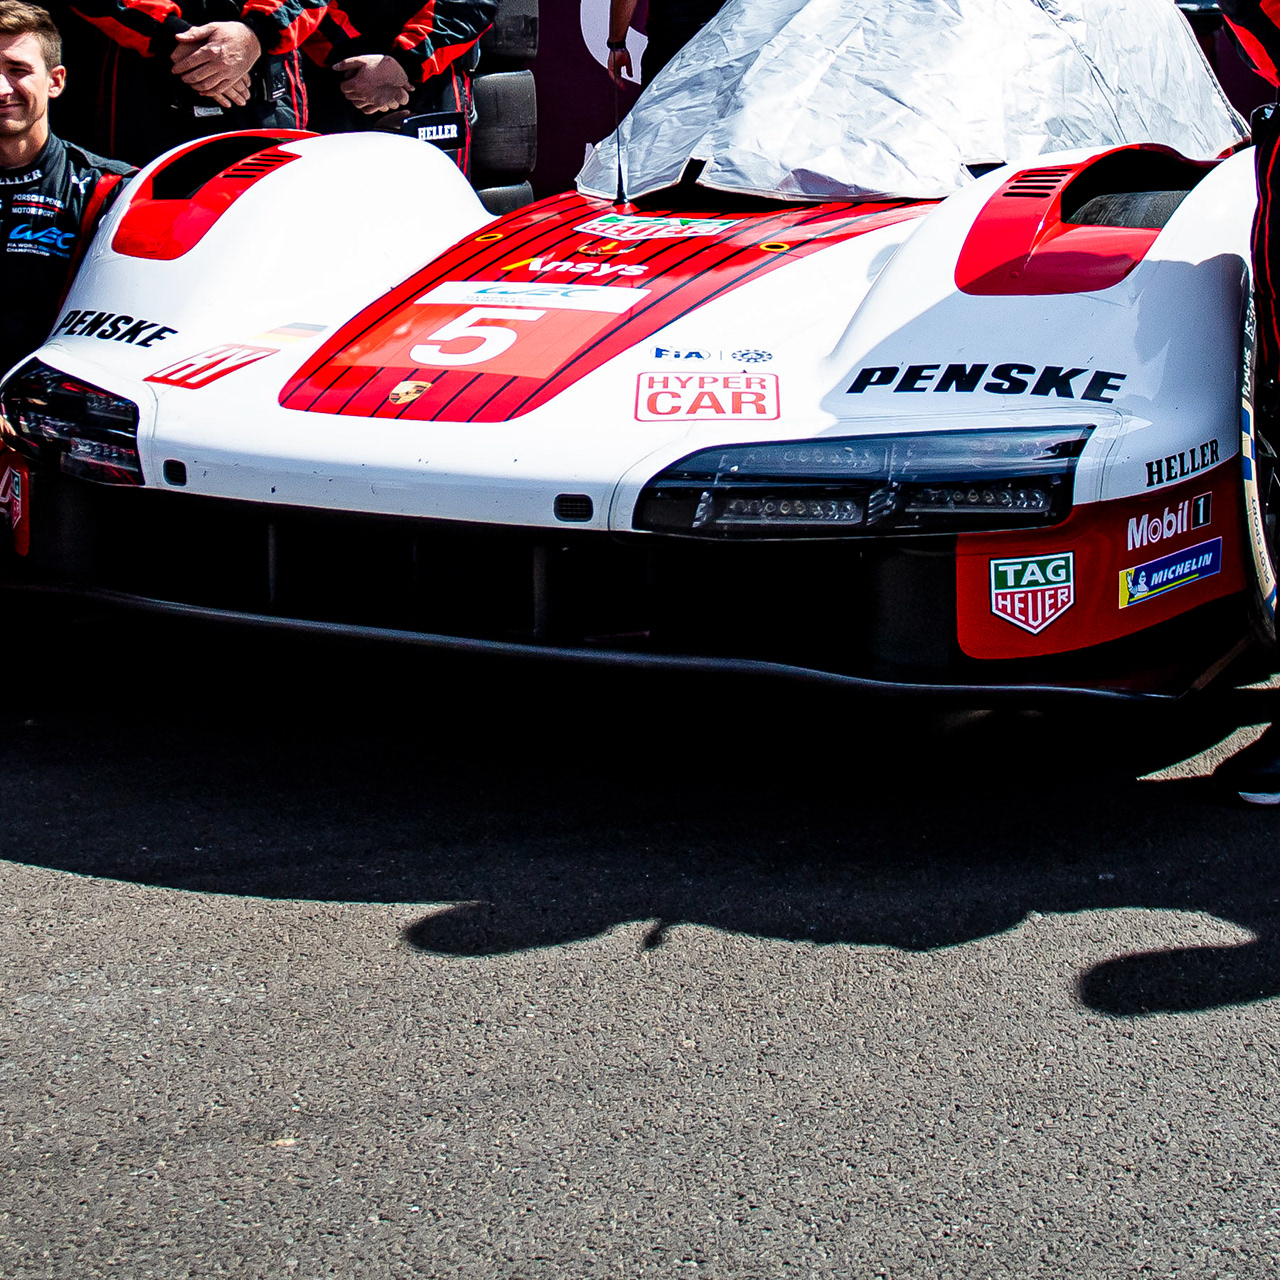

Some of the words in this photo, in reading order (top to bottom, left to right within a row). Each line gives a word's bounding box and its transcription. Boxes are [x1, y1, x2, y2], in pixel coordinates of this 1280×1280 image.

[418, 123, 459, 141] HELLER
[501, 258, 650, 278] Ansys
[53, 309, 180, 349] PENSKE
[409, 306, 548, 367] 5
[647, 375, 768, 391] HYPER
[845, 361, 1129, 405] PENSKE
[645, 391, 768, 416] CAR
[1144, 437, 1221, 488] HELLER
[1126, 499, 1190, 552] Mobil
[998, 560, 1068, 586] TAG
[1150, 552, 1214, 587] MICHELIN
[996, 586, 1073, 629] HEUER
